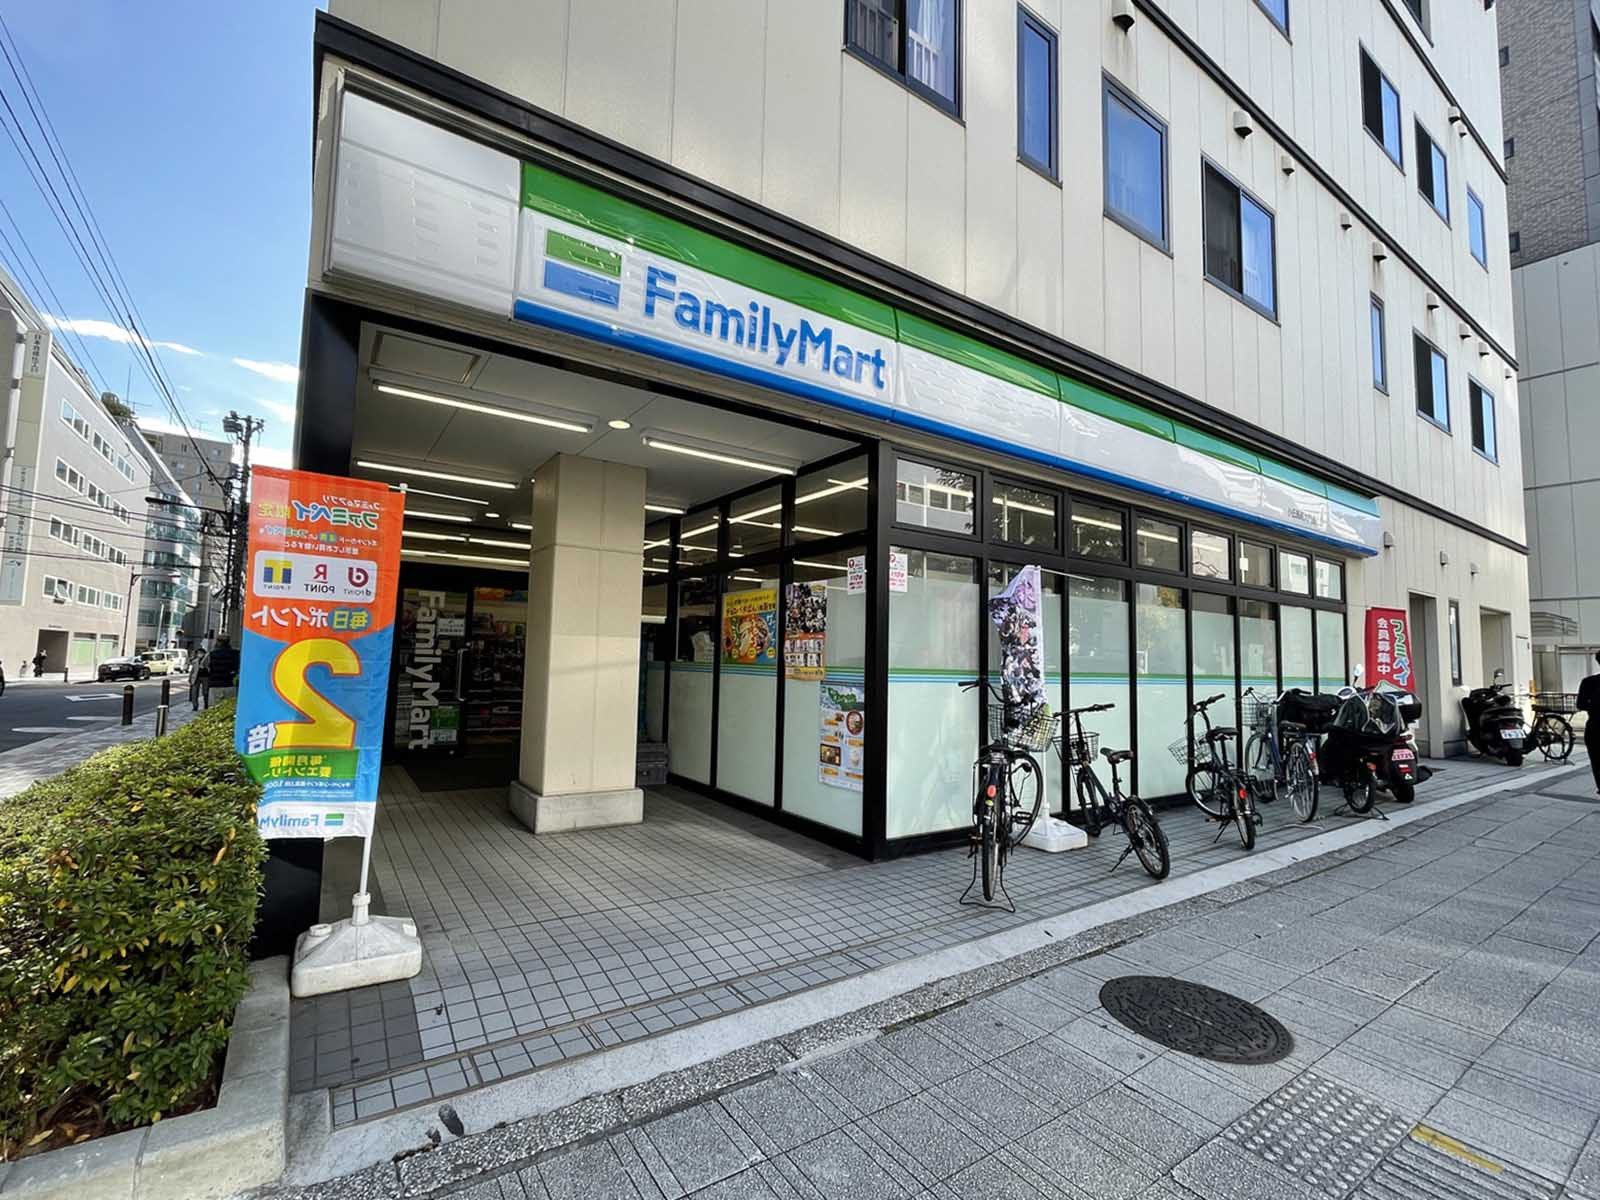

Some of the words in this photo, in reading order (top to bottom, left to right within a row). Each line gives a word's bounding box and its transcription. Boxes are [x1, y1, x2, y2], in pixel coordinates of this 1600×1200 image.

[643, 266, 885, 390] FamilyMart
[405, 590, 446, 750] FamilyMart
[1390, 618, 1410, 686] ファミペイ
